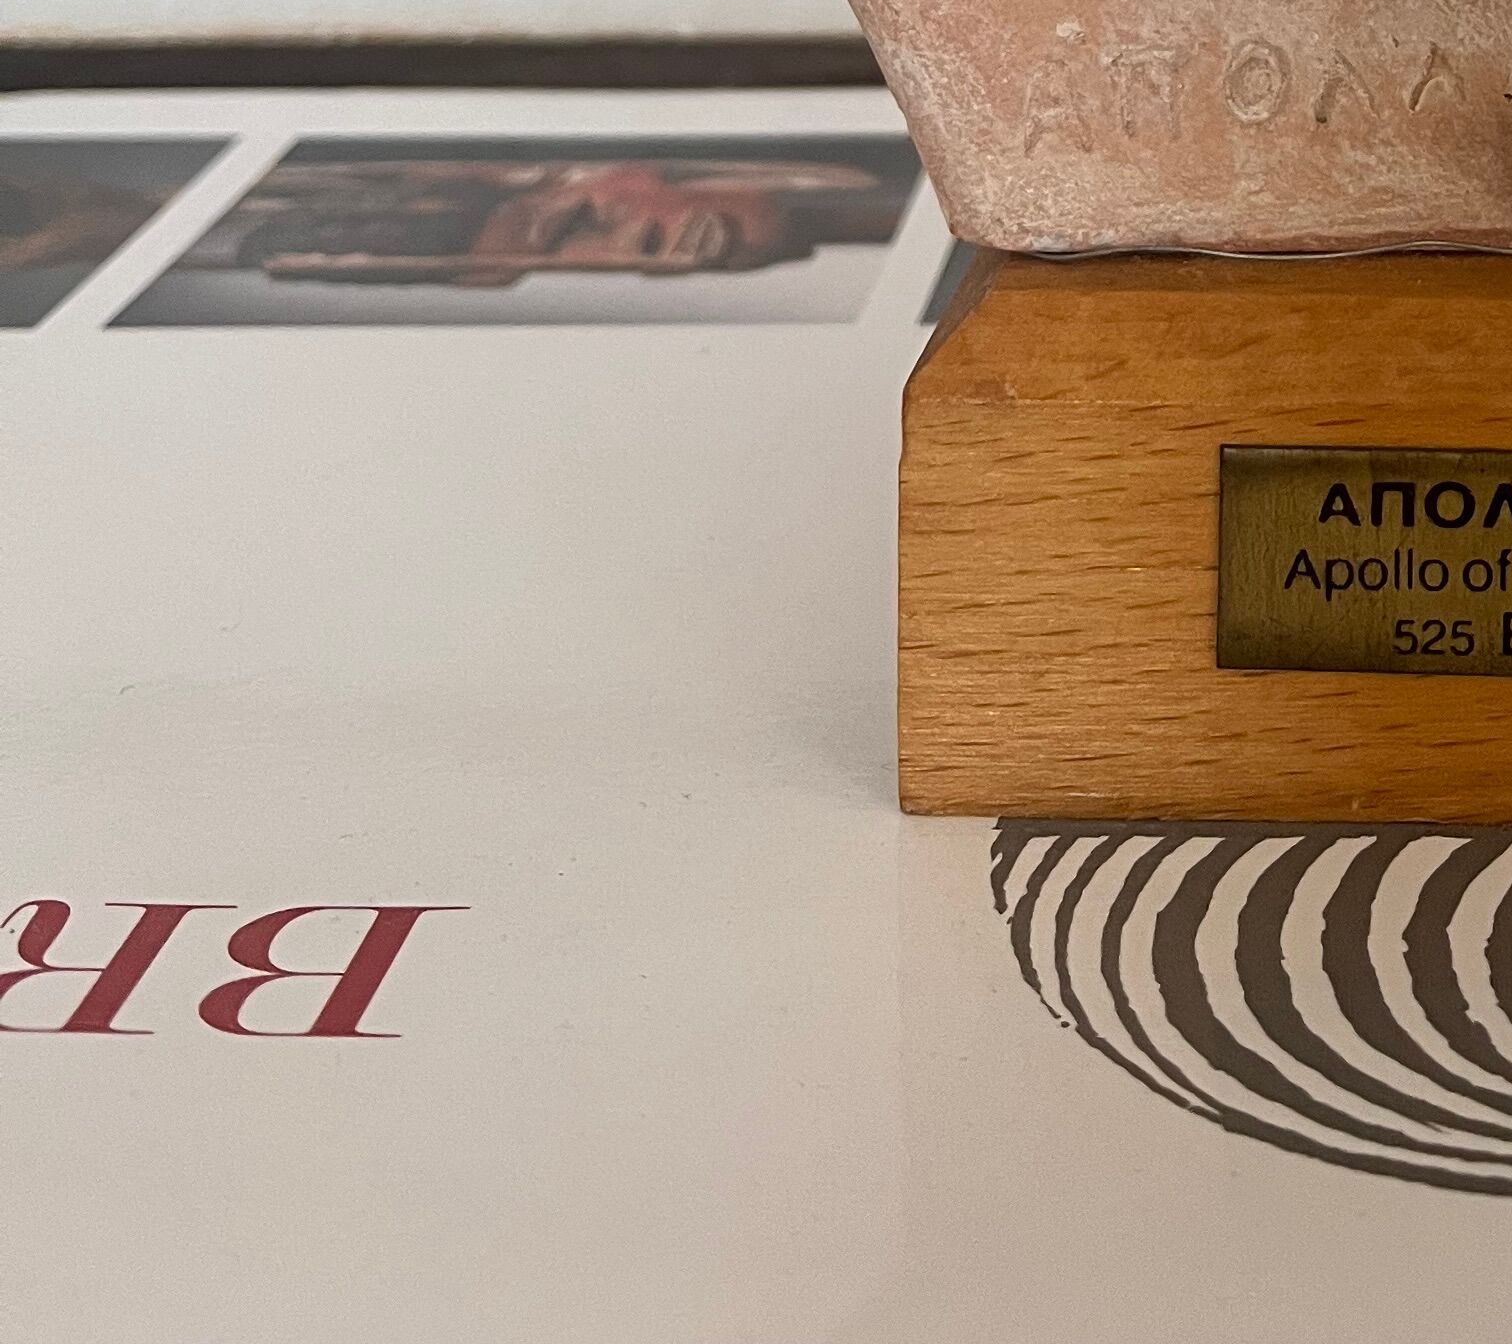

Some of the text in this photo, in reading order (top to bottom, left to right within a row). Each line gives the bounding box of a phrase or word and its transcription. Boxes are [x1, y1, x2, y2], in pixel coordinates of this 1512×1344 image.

[1284, 547, 1449, 601] Apollo
[1462, 549, 1511, 592] of
[1393, 618, 1476, 657] 525
